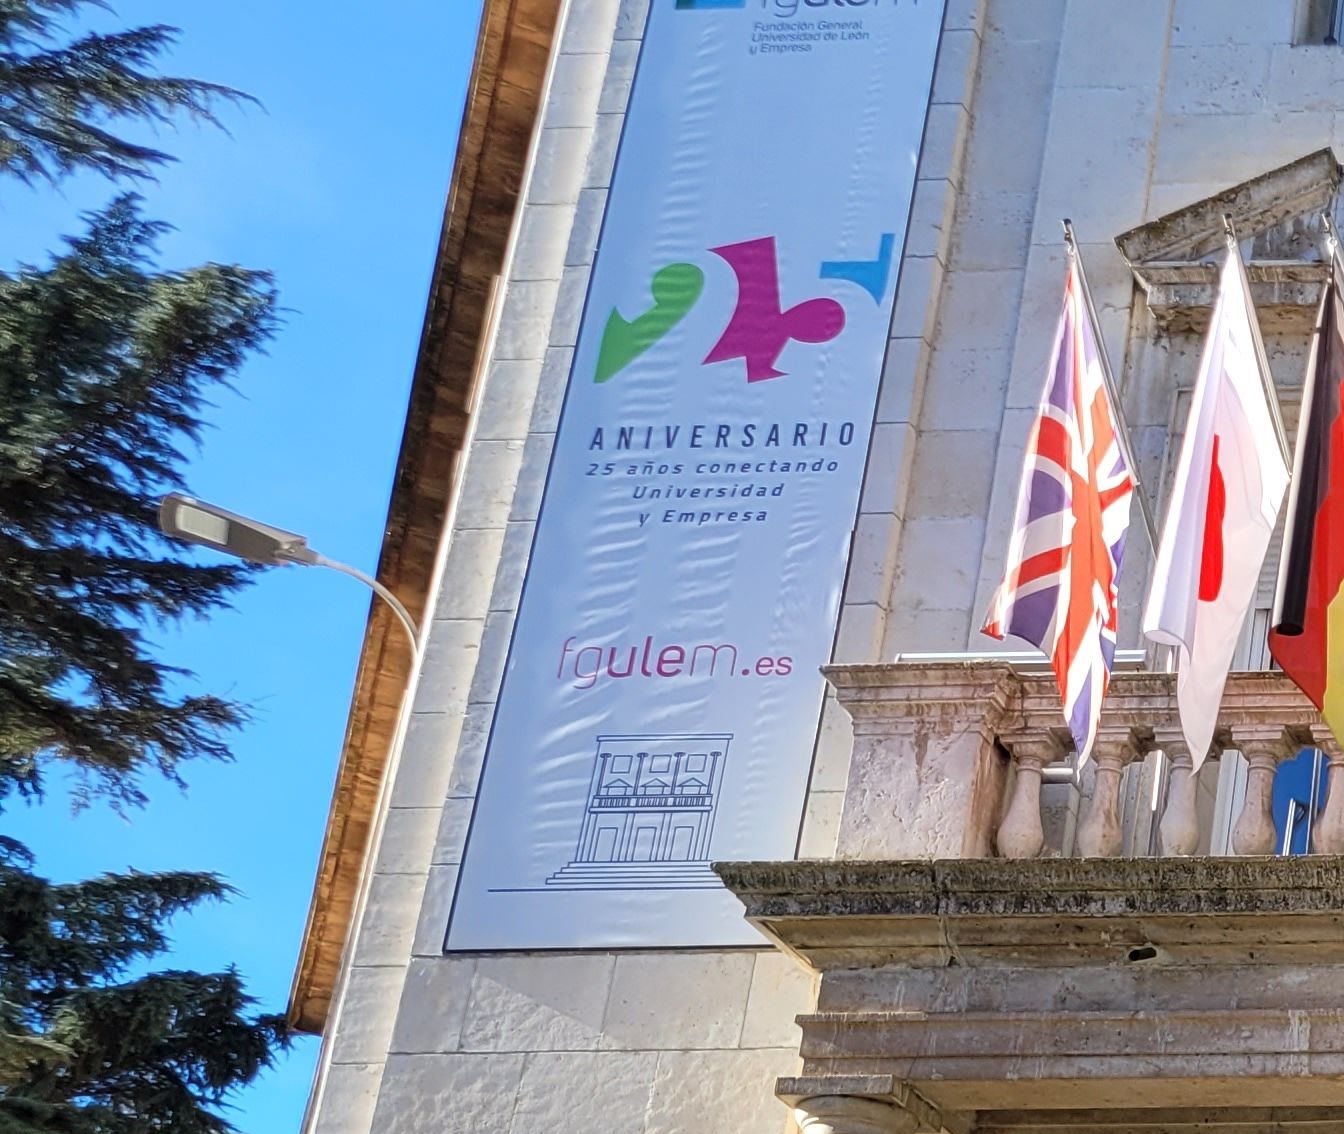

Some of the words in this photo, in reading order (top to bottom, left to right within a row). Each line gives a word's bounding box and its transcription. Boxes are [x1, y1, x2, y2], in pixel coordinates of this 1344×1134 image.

[754, 20, 815, 32] Fundación
[817, 19, 863, 30] General
[751, 31, 820, 42] Universidad
[823, 31, 838, 41] de
[841, 30, 870, 41] León
[760, 42, 812, 53] Empresa
[588, 422, 855, 451] ANIVERSARIO
[585, 462, 616, 476] 25
[626, 460, 685, 476] años
[695, 458, 840, 475] conectando
[632, 483, 785, 500] Universidad
[638, 511, 650, 527] y
[661, 509, 768, 526] Empresa
[556, 635, 794, 690] fgulem.es
